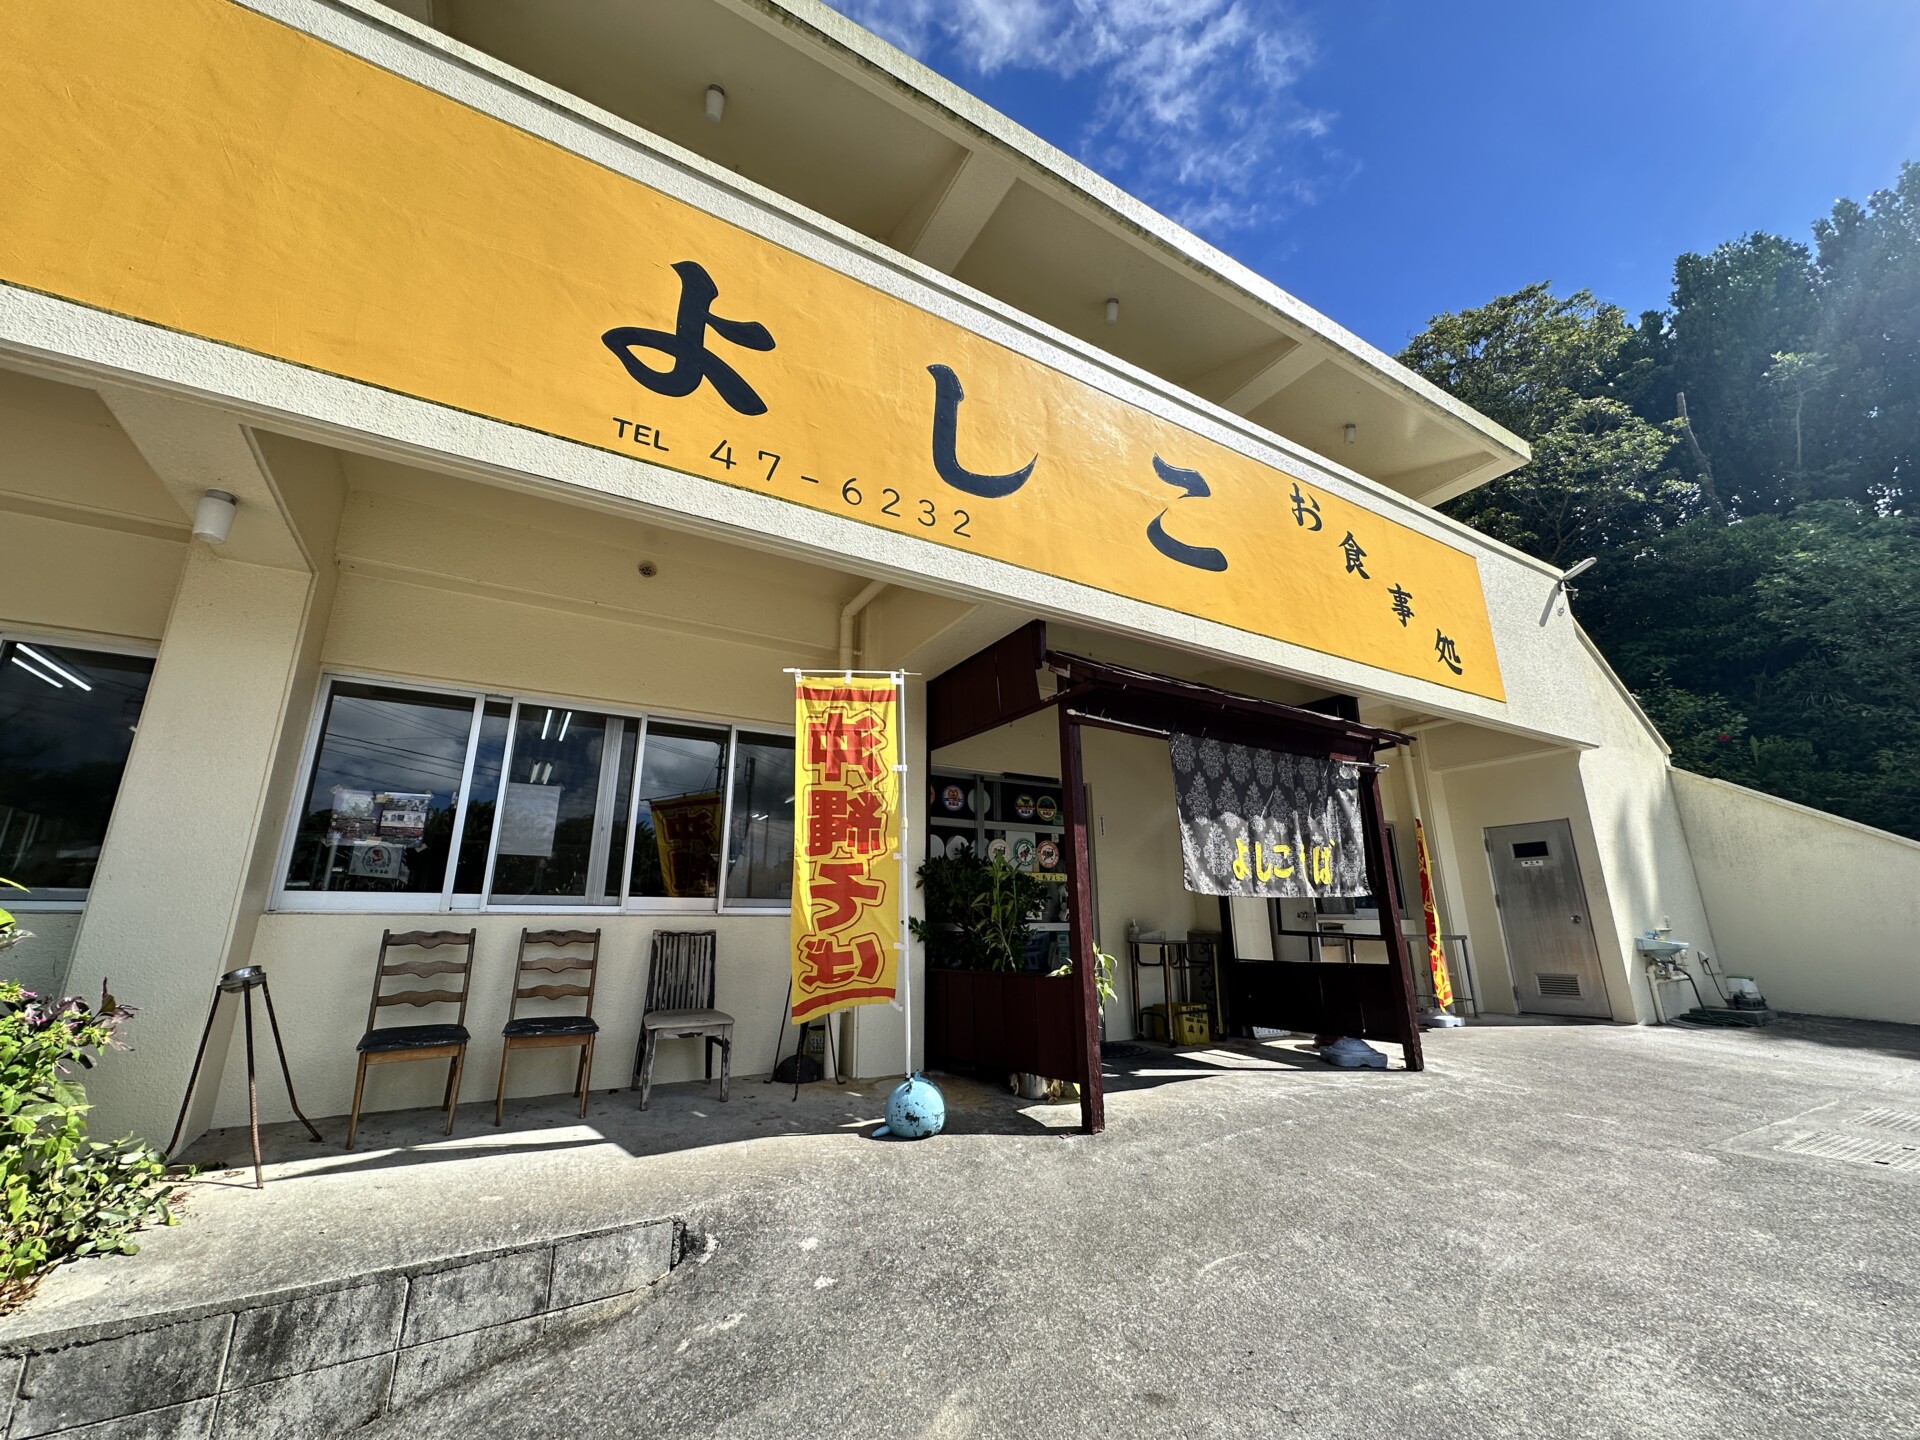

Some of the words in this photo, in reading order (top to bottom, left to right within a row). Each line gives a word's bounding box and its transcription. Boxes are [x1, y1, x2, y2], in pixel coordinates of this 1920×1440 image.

[601, 261, 1228, 572] よしこ
[612, 417, 669, 452] TEL
[709, 439, 971, 538] 47-6232
[1290, 483, 1463, 675] お食事処
[1232, 837, 1335, 885] よしこば
